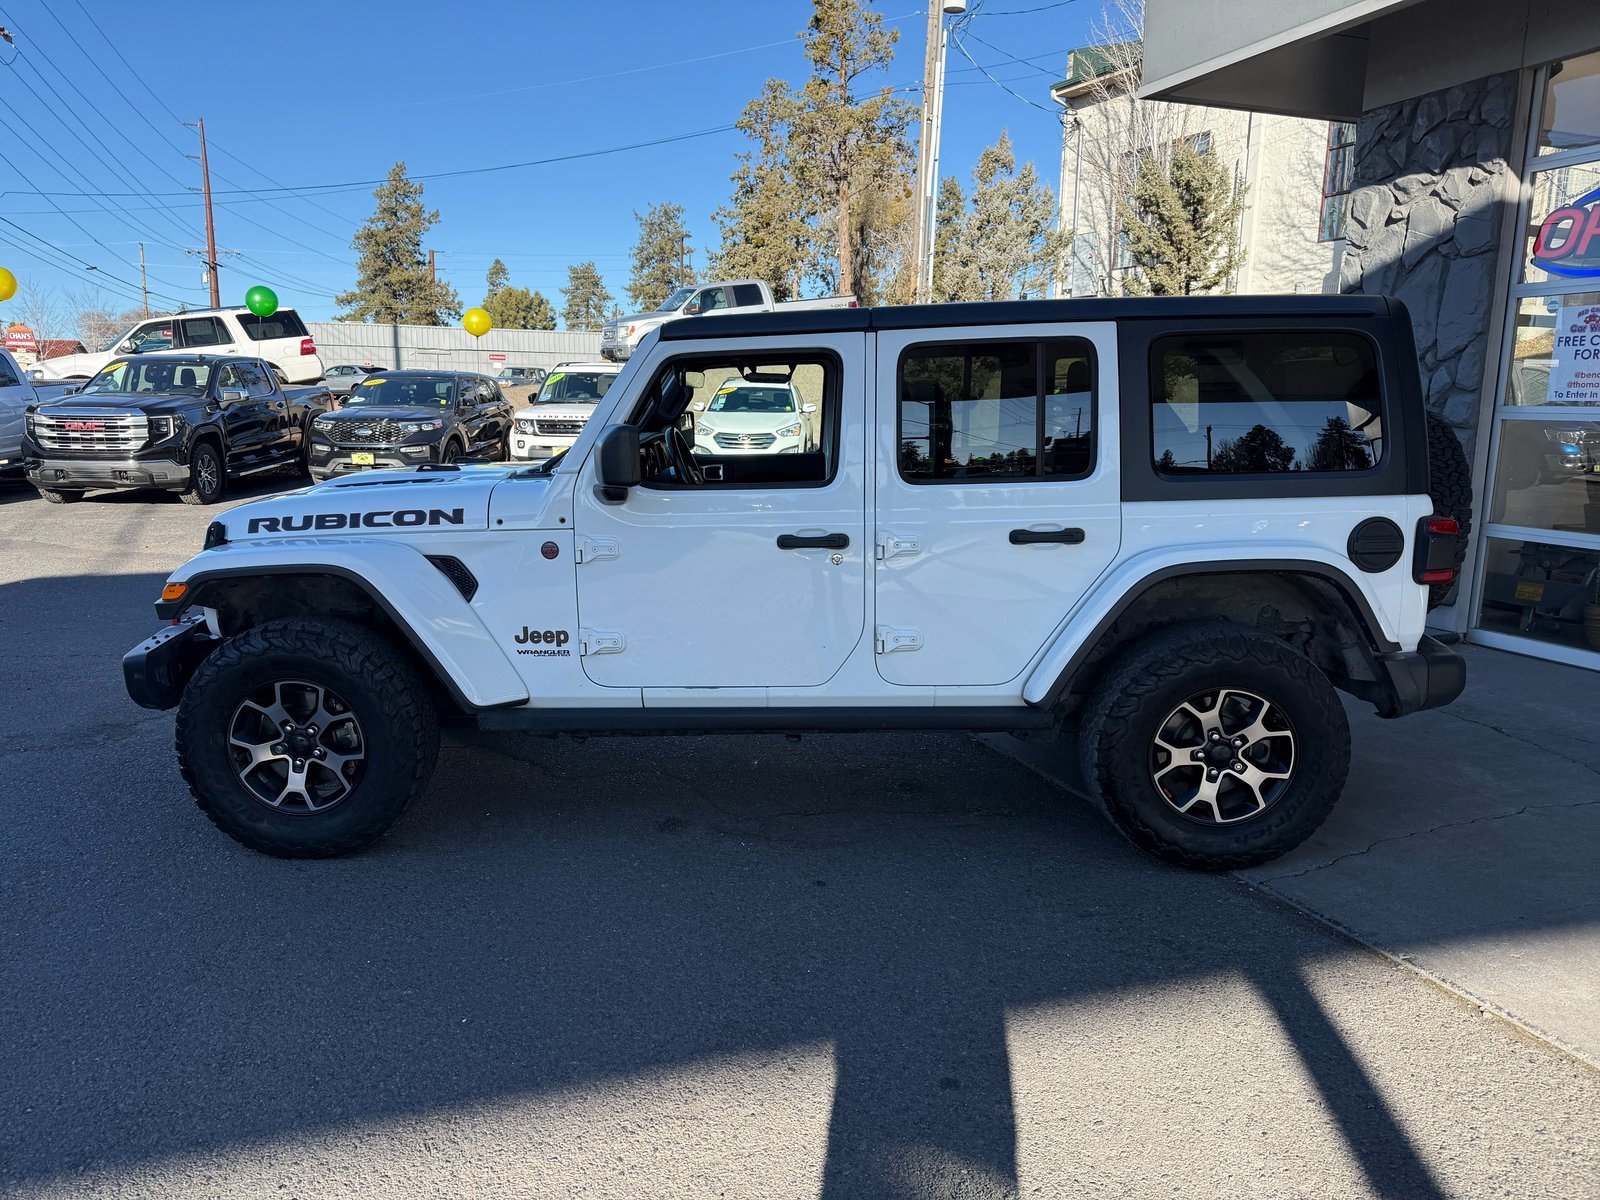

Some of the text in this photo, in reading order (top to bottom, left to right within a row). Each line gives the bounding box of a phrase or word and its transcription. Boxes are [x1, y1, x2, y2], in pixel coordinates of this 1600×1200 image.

[1570, 324, 1587, 333] Car
[1557, 335, 1586, 347] FREE
[1573, 348, 1600, 360] FOR
[1554, 390, 1598, 399] To Enter In
[64, 421, 106, 431] GMC
[248, 508, 464, 534] RUBICON
[514, 625, 569, 648] Jeep
